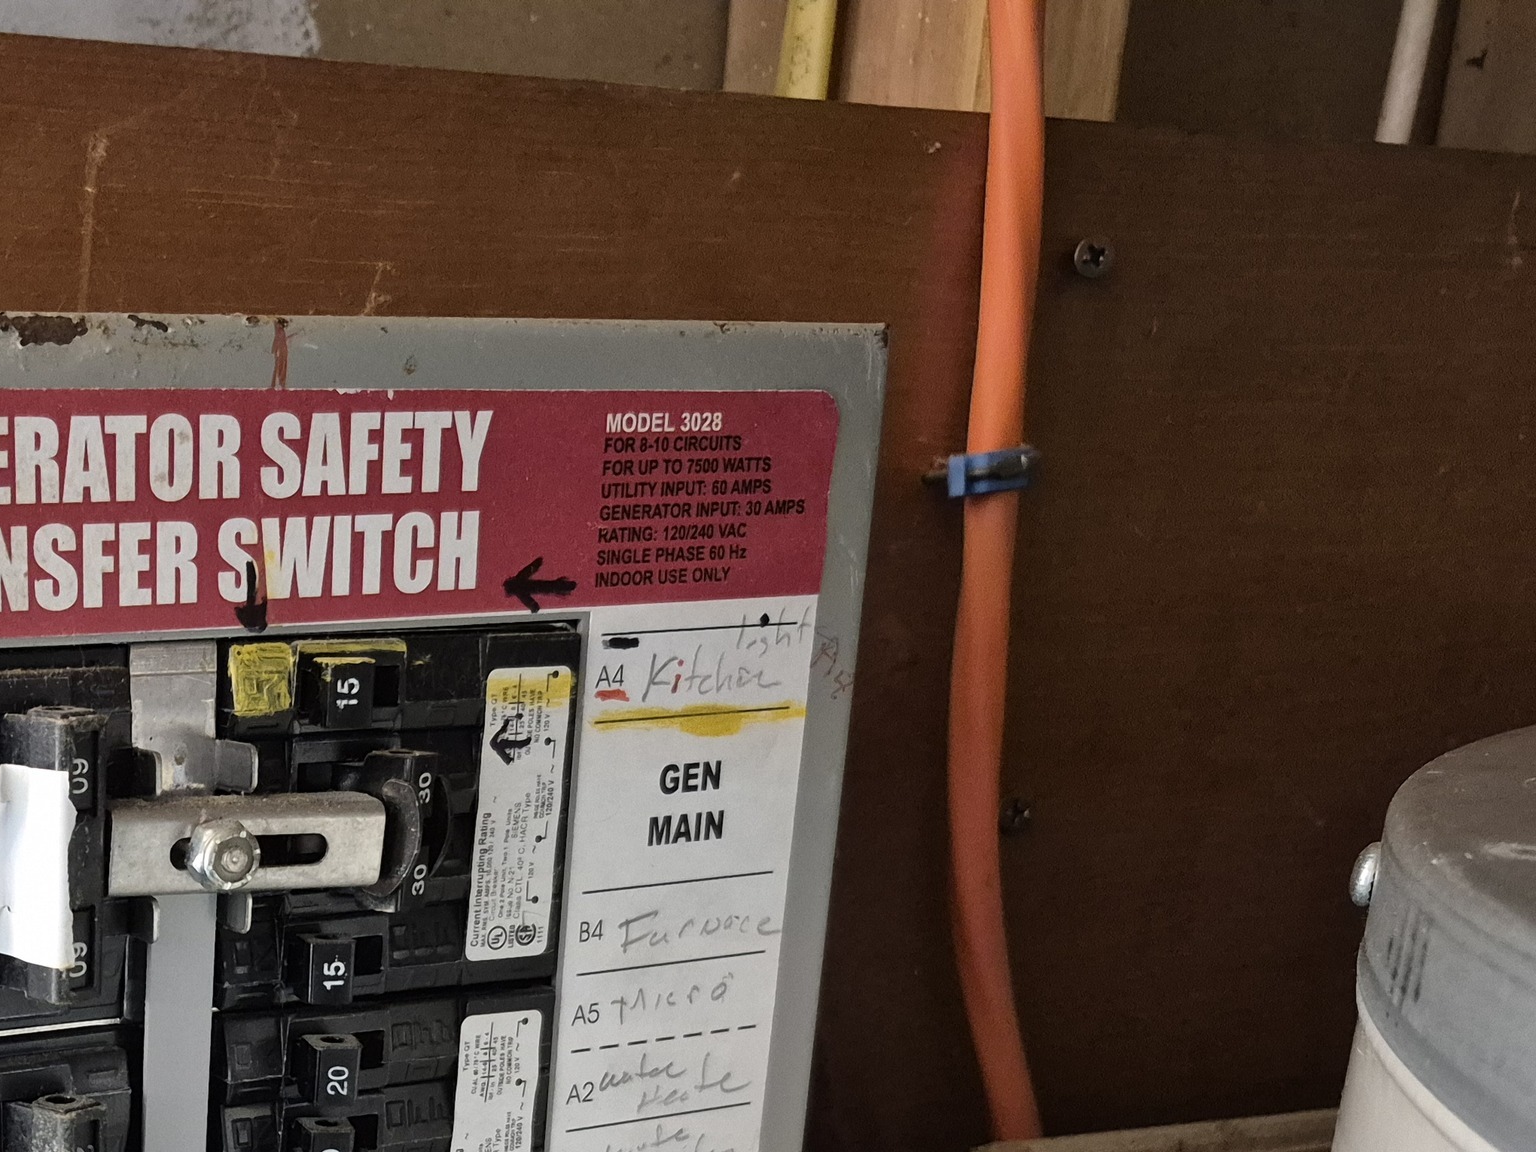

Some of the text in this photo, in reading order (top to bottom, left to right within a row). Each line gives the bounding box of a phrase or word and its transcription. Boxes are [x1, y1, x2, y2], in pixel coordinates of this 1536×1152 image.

[606, 412, 723, 433] MODEL 3028
[261, 410, 493, 498] SAFETY
[604, 435, 742, 453] FOR 8-10 CIRCUITS
[602, 457, 772, 476] FOR UP TO 7500 WATTS
[601, 479, 772, 499] UTILITY INPUT: 60 AMPS
[600, 499, 806, 521] GENERATOR INPUT: 30 AMPS
[598, 523, 747, 544] RATING: 120/240 VAC
[217, 510, 480, 602] SWITCH
[596, 544, 747, 566] SINGLE PHASE 60 Hz
[595, 566, 731, 588] INDOOR USE ONLY
[595, 664, 625, 689] A4
[336, 678, 360, 709] 15
[72, 758, 89, 794] 60
[418, 772, 432, 804] 30
[659, 760, 722, 795] GEN
[647, 809, 725, 847] MAIN
[412, 864, 427, 896] 30
[470, 812, 492, 947] Current Interrupting Rating
[579, 920, 604, 943] B4
[323, 960, 347, 991] 15
[571, 1002, 601, 1027] A5
[327, 1065, 350, 1097] 20
[566, 1081, 595, 1106] A2
